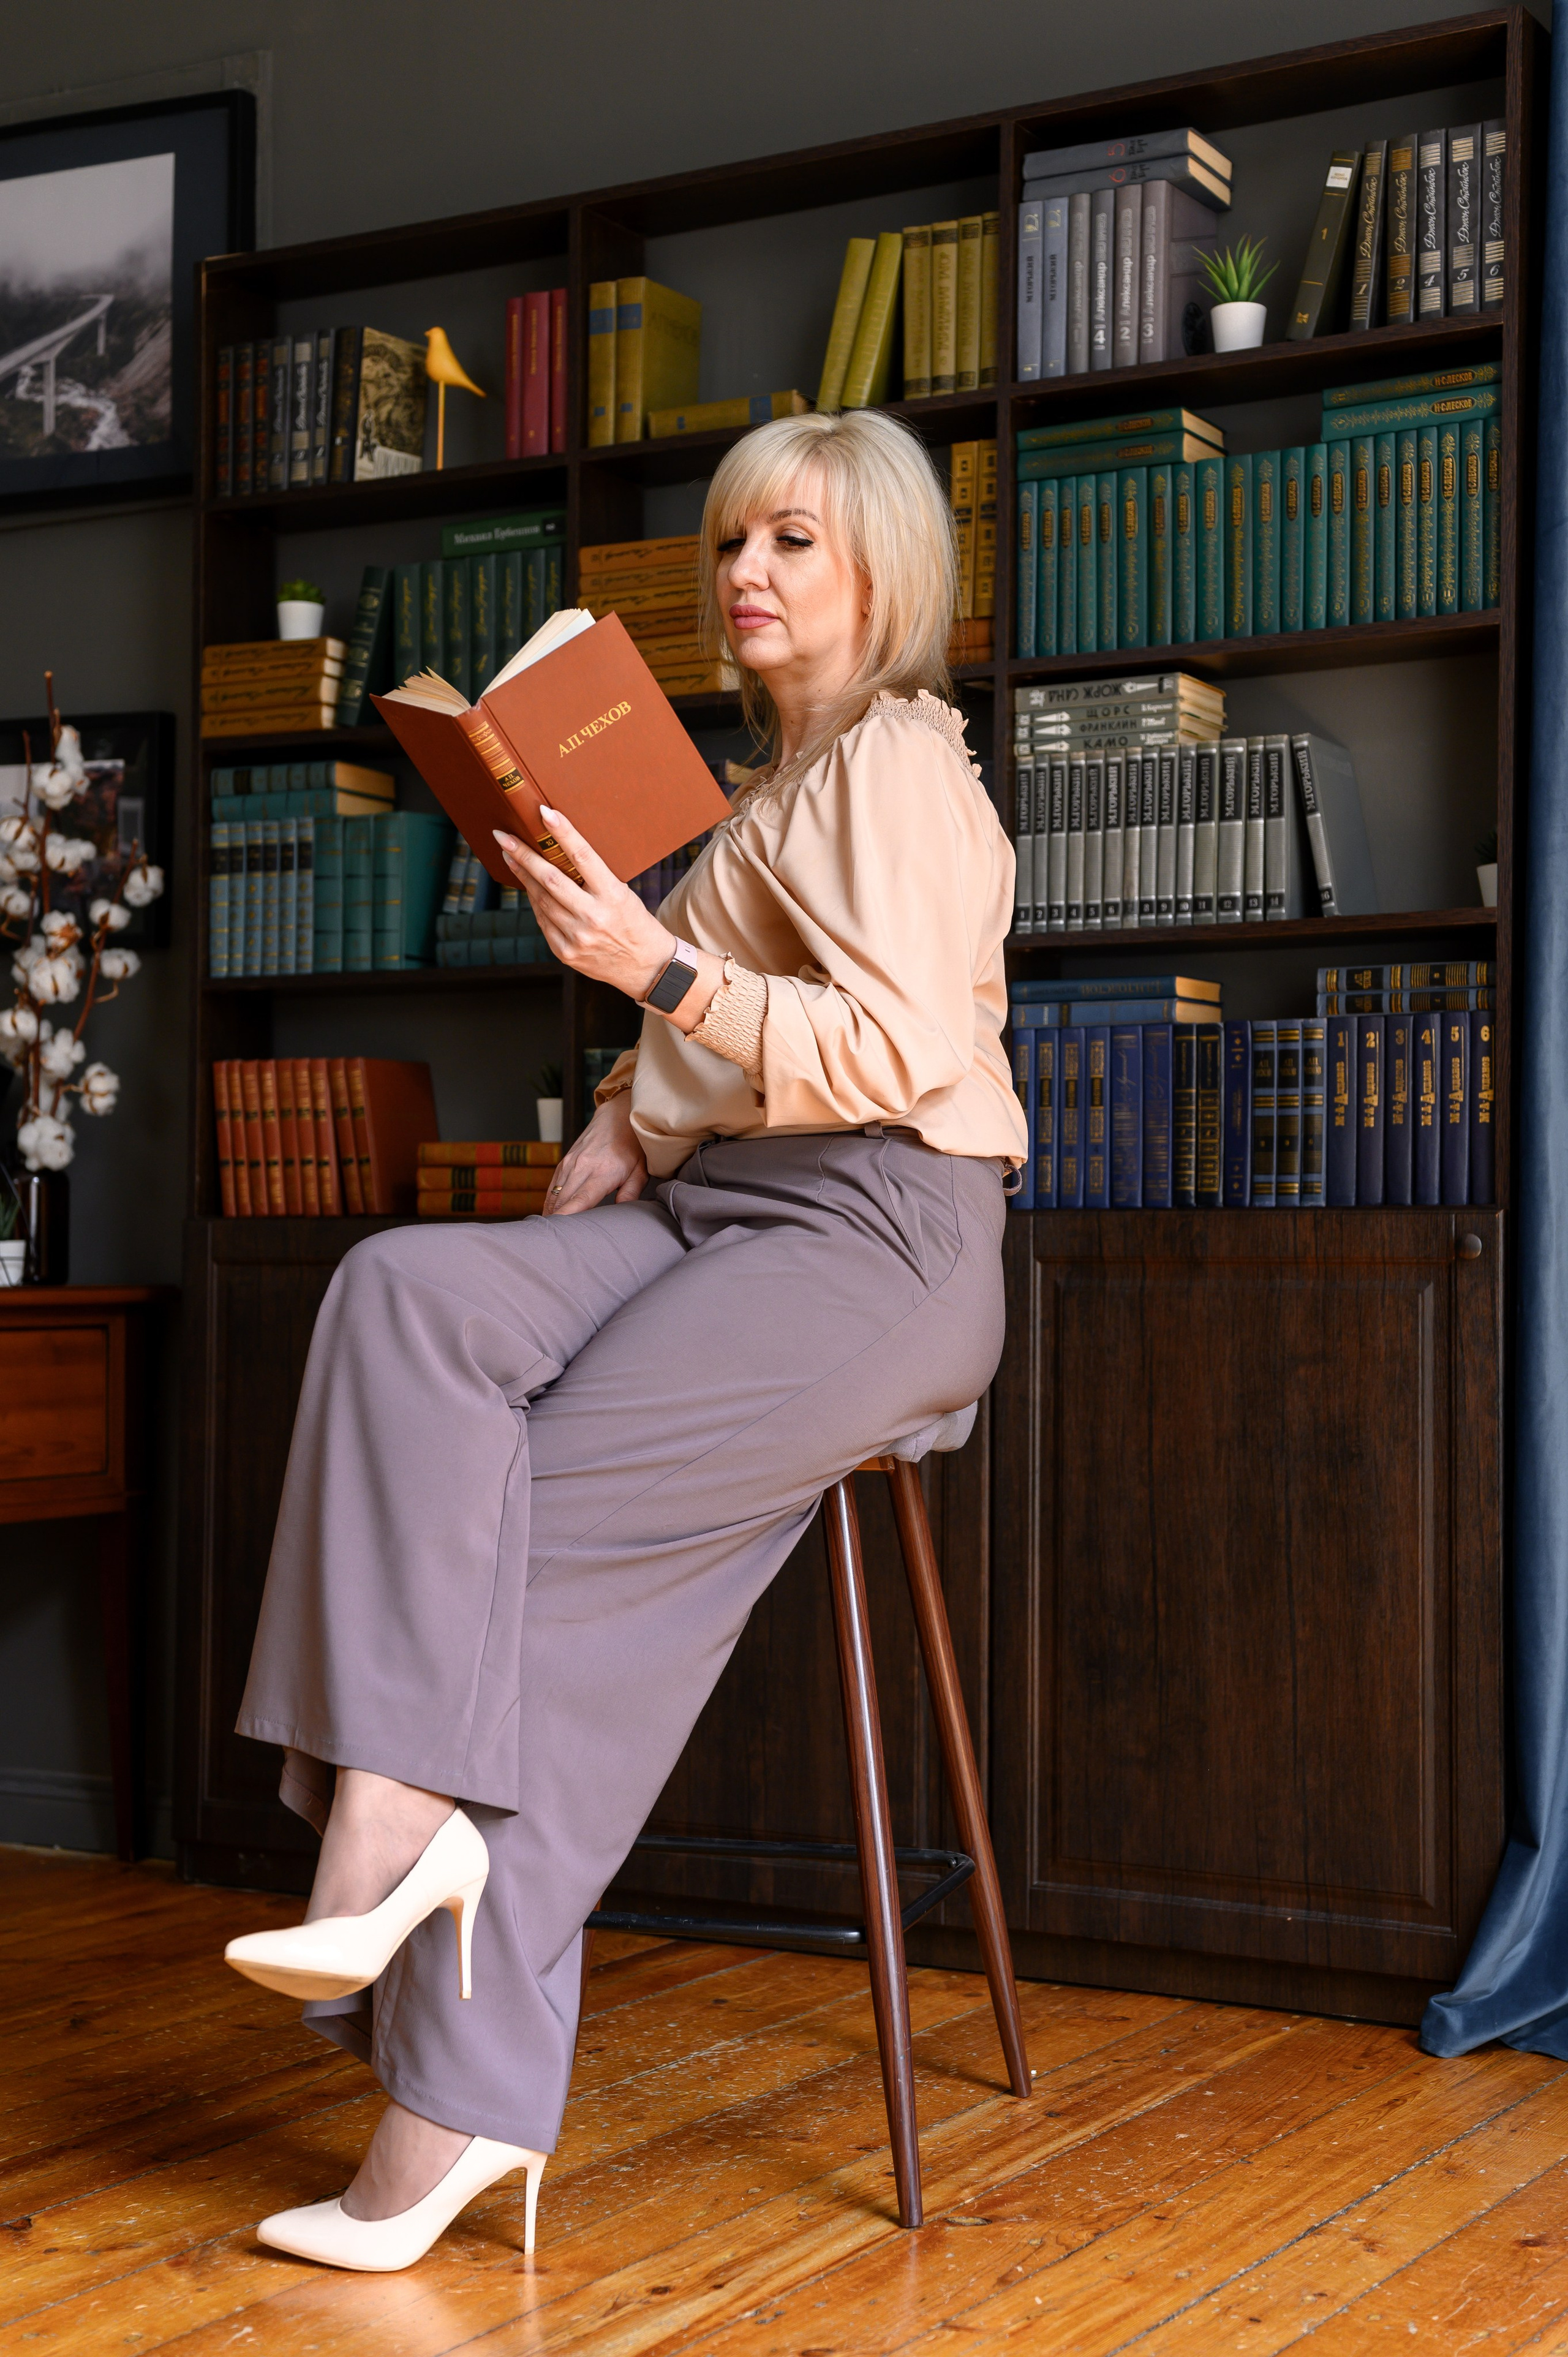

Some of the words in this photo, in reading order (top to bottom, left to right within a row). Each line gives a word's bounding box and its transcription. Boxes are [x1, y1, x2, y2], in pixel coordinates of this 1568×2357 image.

[1108, 143, 1125, 157] 5
[1110, 167, 1126, 183] 6
[1488, 156, 1501, 205] Стейнбек
[1423, 167, 1436, 216] Стейнбек
[1457, 162, 1469, 211] Стейнбек
[1456, 210, 1469, 244] Джон
[1488, 204, 1501, 238] Джон
[1423, 215, 1436, 249] Джон
[1083, 681, 1123, 698] ЖОРЖ
[1086, 706, 1131, 719] ЩОРС
[559, 743, 584, 758] А.П.
[579, 701, 631, 738] ЧЕХОВ
[1079, 719, 1137, 733] ФРАНКЛИН
[1084, 736, 1128, 749] КАМО
[502, 775, 521, 787] ЧЕХОВ
[1108, 905, 1115, 915] 6
[1248, 898, 1257, 907] 13
[1020, 910, 1025, 919] 1
[1036, 909, 1042, 919] 2
[1052, 908, 1058, 918] 3
[1336, 1031, 1344, 1047] 1
[1366, 1031, 1376, 1048] 2
[1395, 1029, 1404, 1045] 3
[1420, 1028, 1431, 1045] 4
[1450, 1026, 1460, 1042] 5
[1480, 1025, 1490, 1042] 6
